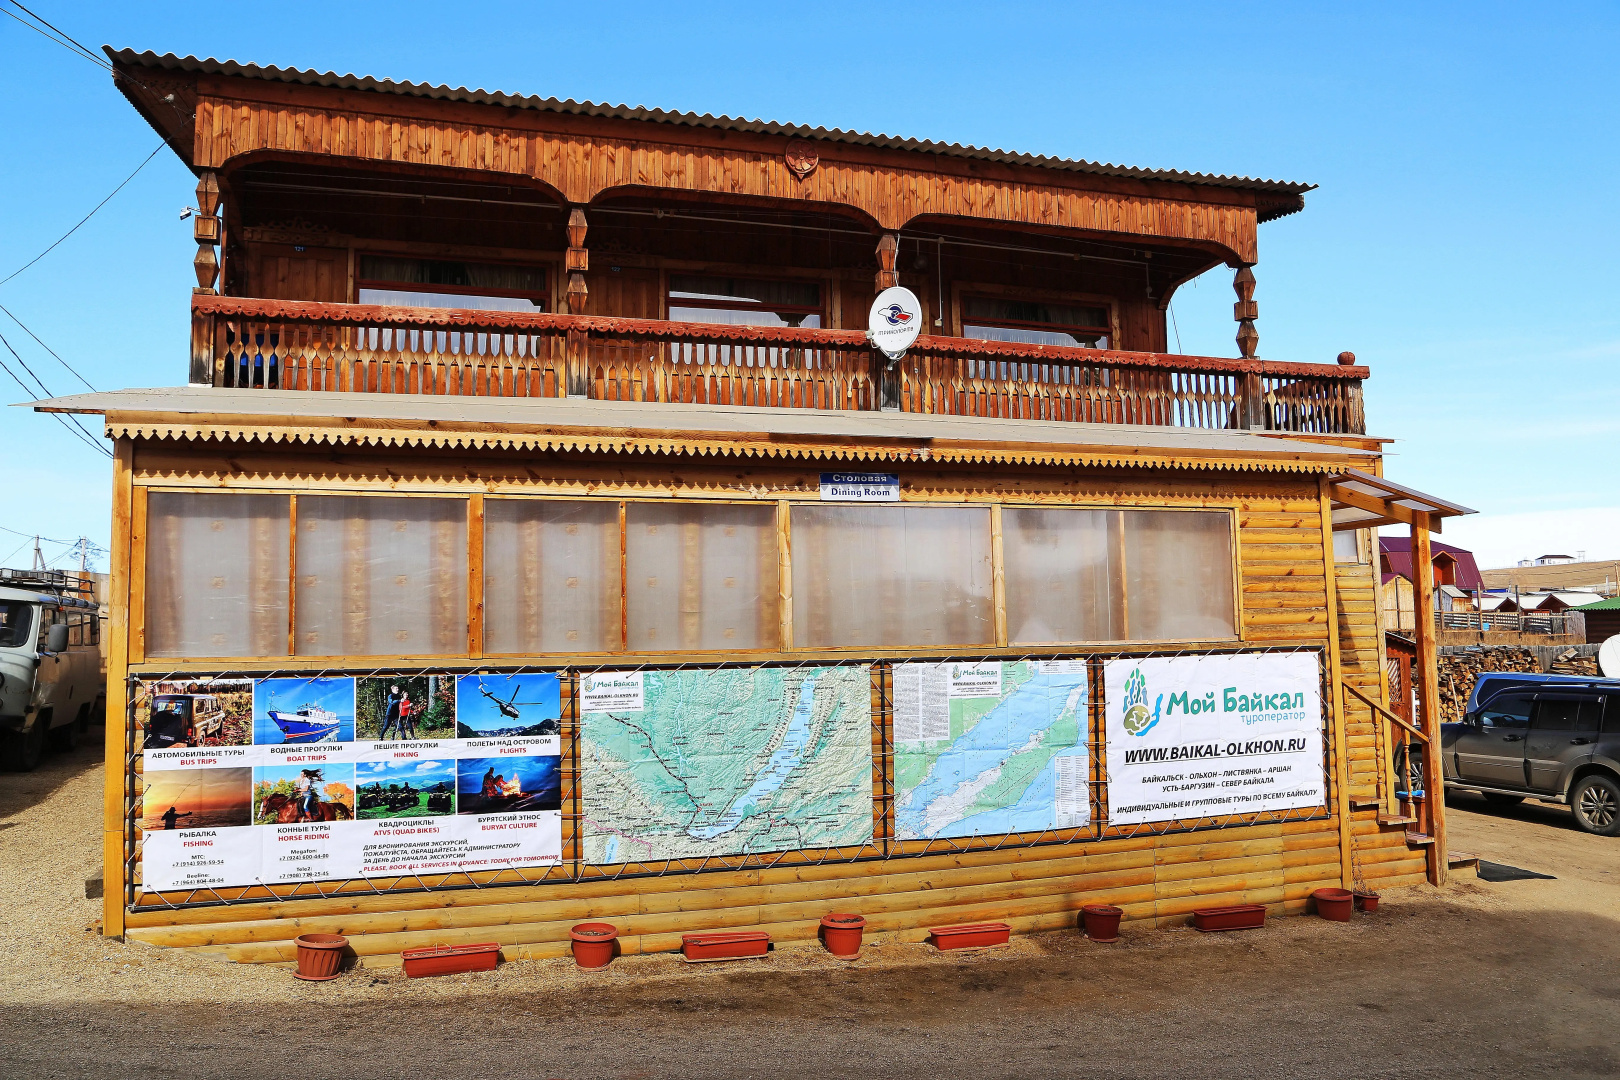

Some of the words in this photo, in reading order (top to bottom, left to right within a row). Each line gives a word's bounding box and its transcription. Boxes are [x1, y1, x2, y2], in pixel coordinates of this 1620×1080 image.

[832, 474, 887, 482] Столовая
[831, 488, 862, 498] Dining
[864, 488, 890, 497] Room
[1166, 690, 1216, 715] Мой
[1223, 686, 1304, 713] Байкал
[1240, 710, 1306, 726] туроператор
[497, 739, 512, 747] НАД
[513, 738, 552, 746] ОСТРОВОМ
[152, 750, 223, 759] АВТОМОБИЛЬНЫЕ
[224, 749, 245, 757] ТУРЫ
[270, 747, 303, 755] ВОДНЫЕ
[303, 745, 343, 753] ПРОГУЛКИ
[1124, 737, 1307, 764] WWW.BAIKAL-OLKHON.RU
[287, 755, 306, 763] BOAT
[306, 754, 327, 762] TRIPS
[1141, 773, 1184, 784] БАЙКАЛЬСК
[1189, 771, 1217, 780] ОЛЬХОН
[1222, 767, 1262, 777] ЛИСТВЯНКА
[1267, 765, 1292, 774] АРШАН
[1162, 782, 1215, 793] УСТЬ-БАРГУЗИН
[1221, 780, 1242, 788] СЕВЕР
[1243, 777, 1274, 786] БАЙКАЛА
[1116, 800, 1184, 814] ИНДИВИДУАЛЬНЫЕ
[1184, 799, 1190, 807] И
[1191, 796, 1232, 807] ГРУППОВЫЕ
[1233, 795, 1252, 803] ТУРЫ
[1252, 793, 1262, 802] ПО
[1262, 791, 1286, 801] ВСЕМУ
[1286, 789, 1318, 798] БАЙКАЛУ
[478, 814, 517, 823] БУРЯТСКИЙ
[378, 819, 435, 828] КВАДРОЦИКЛЫ
[481, 823, 508, 831] BURYAT
[508, 822, 538, 830] CULTURE
[179, 830, 217, 839] РЫБАЛКА
[373, 828, 392, 836] ATVS
[392, 827, 416, 836] (QUAD
[416, 826, 440, 834] BIKES)
[278, 834, 303, 842] HORSE
[304, 833, 330, 841] RIDING
[183, 840, 214, 848] FISHING
[378, 841, 430, 850] БРОНИРОВАНИЯ
[410, 846, 457, 854] ОБРАЩАЙТЕСЬ
[464, 843, 521, 852] АДМИНИСТРАТОРУ
[523, 854, 559, 862] TOMORROW
